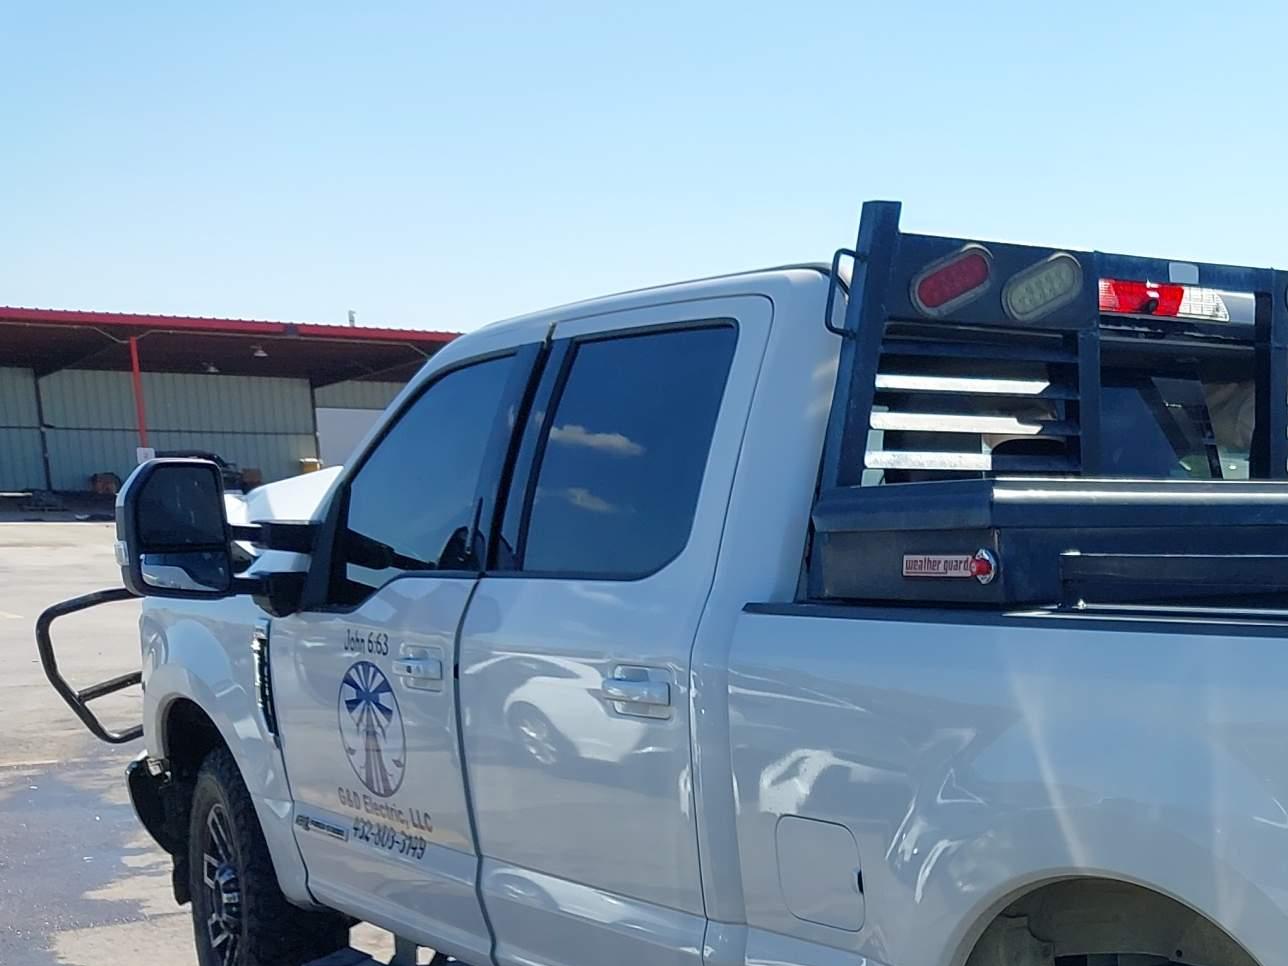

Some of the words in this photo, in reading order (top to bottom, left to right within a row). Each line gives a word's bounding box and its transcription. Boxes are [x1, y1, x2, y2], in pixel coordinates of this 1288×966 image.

[905, 557, 942, 572] weather
[943, 557, 971, 574] guard
[344, 628, 366, 656] John
[409, 807, 434, 833] LLC
